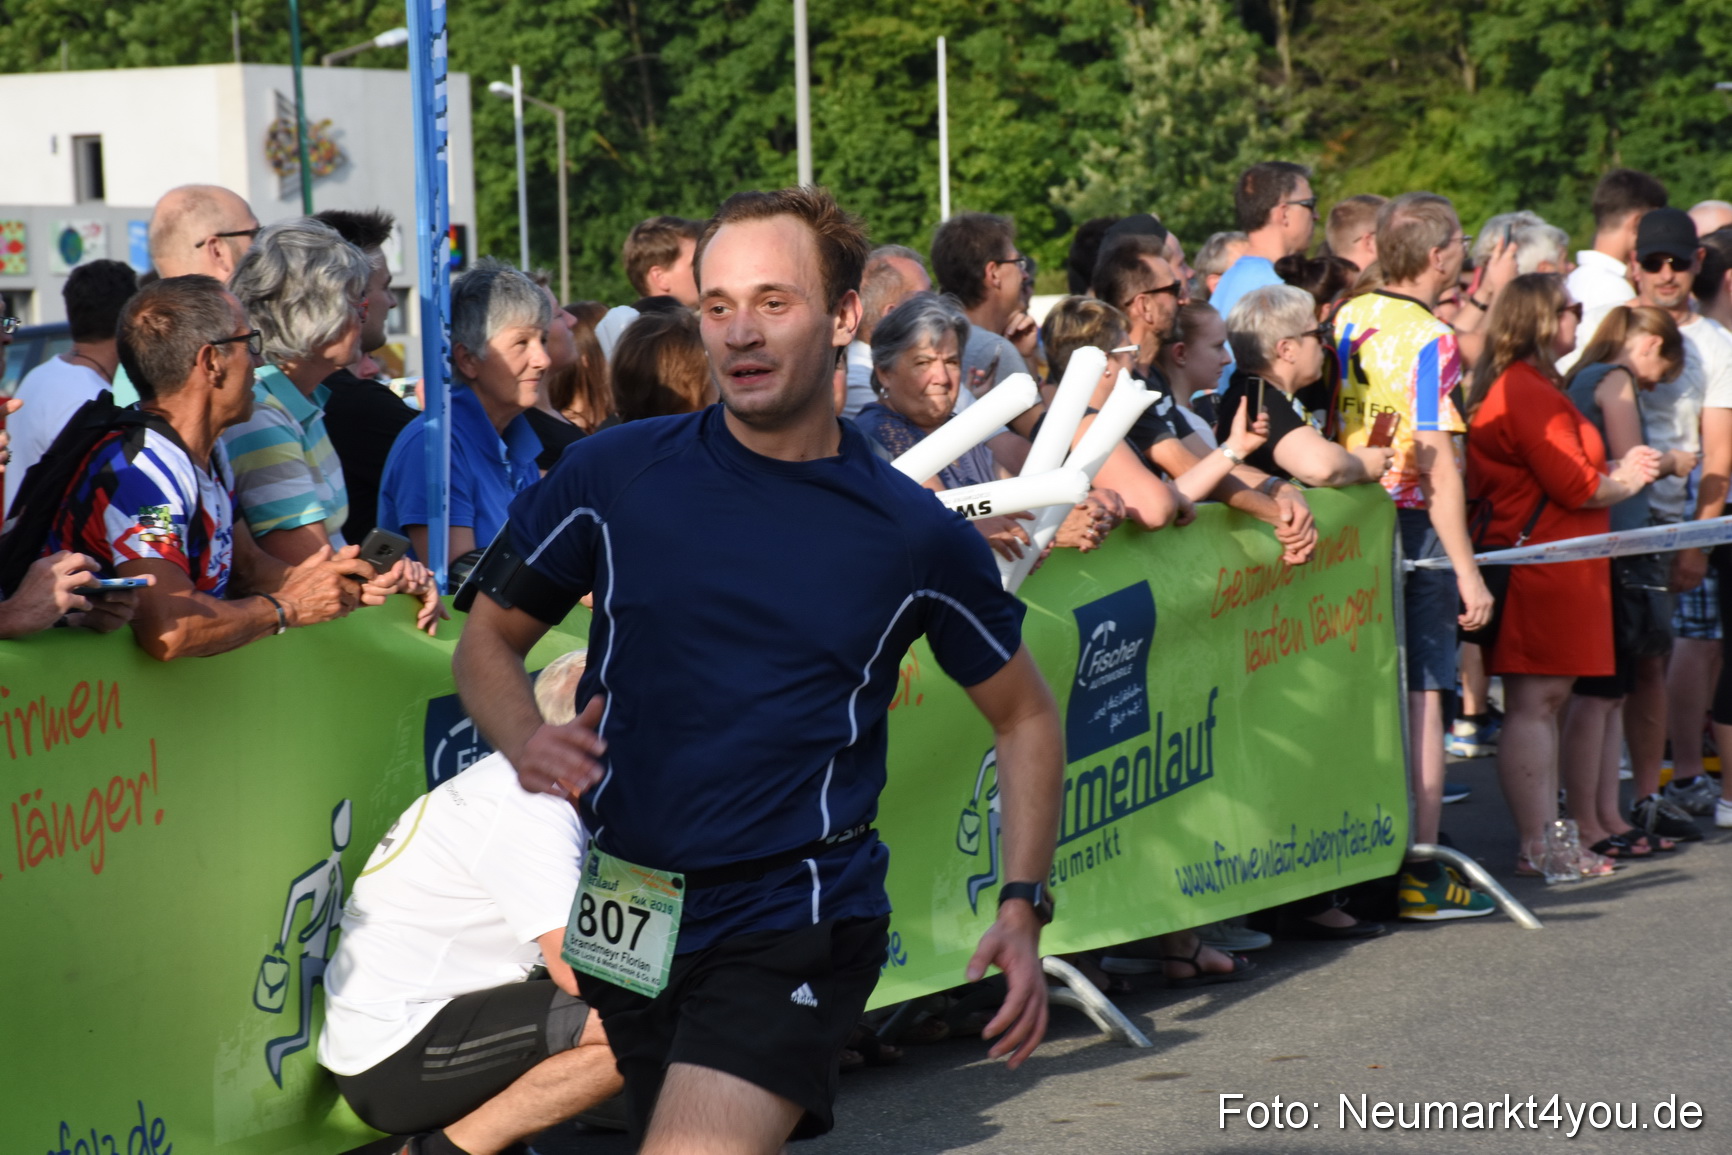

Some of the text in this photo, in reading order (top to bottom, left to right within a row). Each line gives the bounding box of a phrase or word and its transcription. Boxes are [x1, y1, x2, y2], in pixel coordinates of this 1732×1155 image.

[948, 500, 992, 519] MS
[1302, 525, 1363, 581] irmen
[1244, 566, 1384, 674] laufen länger!
[1087, 637, 1144, 678] Fischer
[0, 679, 123, 760] irmen
[1060, 686, 1219, 845] rmenlauf
[12, 737, 164, 874] länger!
[1050, 827, 1121, 888] eumarkt
[578, 892, 651, 951] 807
[620, 951, 651, 973] Florian
